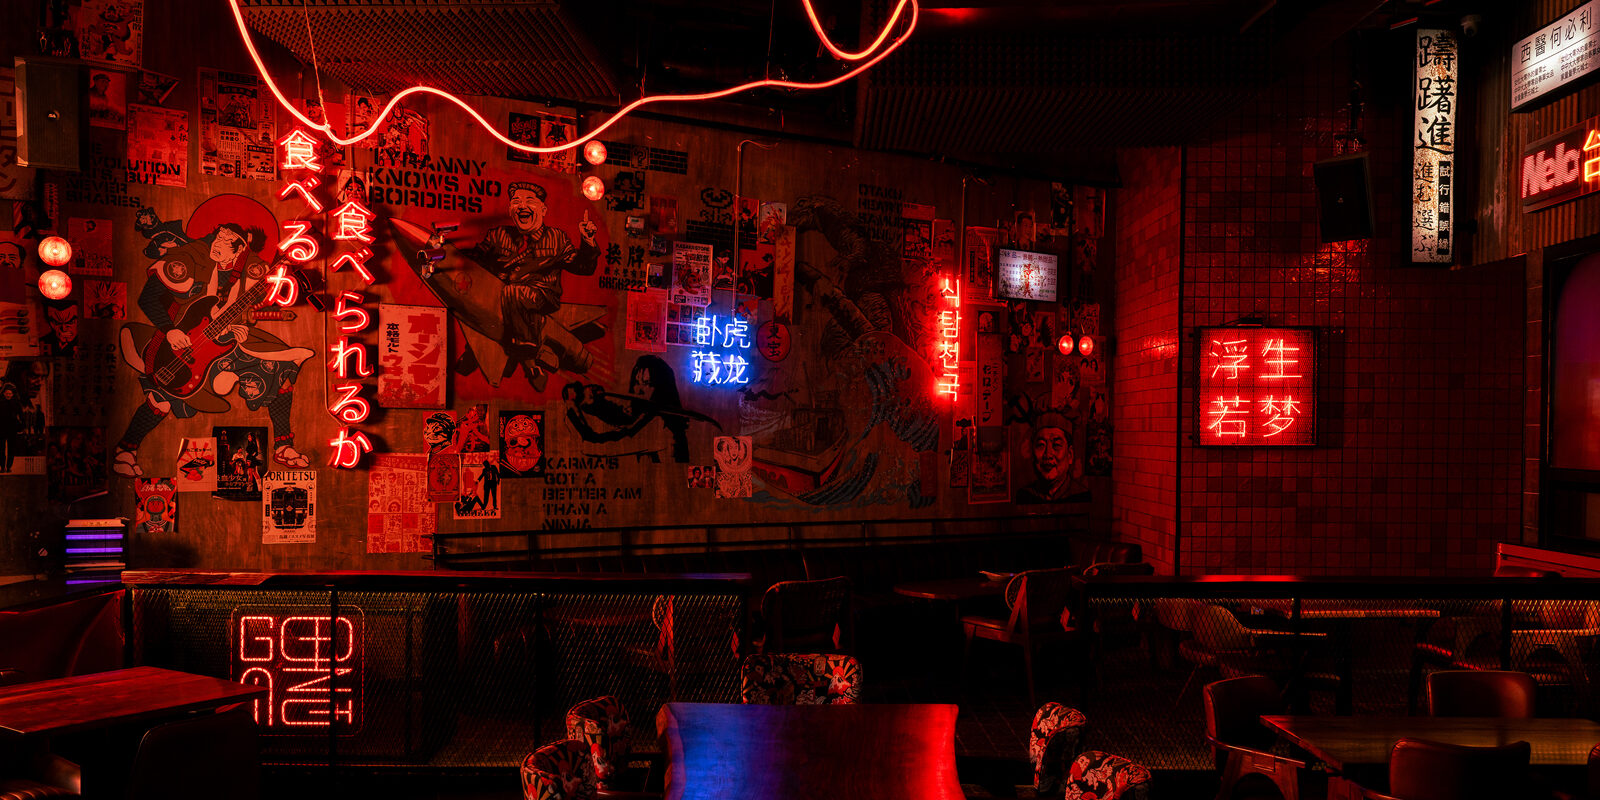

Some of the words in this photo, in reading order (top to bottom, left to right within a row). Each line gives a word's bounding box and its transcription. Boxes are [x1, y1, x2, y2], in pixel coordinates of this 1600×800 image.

[1520, 6, 1592, 64] 西醫何必利
[369, 147, 487, 177] TYRANNY
[66, 176, 128, 194] NEVER
[124, 170, 160, 186] BUT
[369, 166, 460, 193] KNOWS
[468, 179, 502, 197] NO
[858, 183, 903, 200] OTAKU
[369, 185, 482, 213] BORDERS
[858, 199, 903, 215] HEART
[266, 129, 323, 308] 食べるか
[328, 202, 374, 469] 食べられるか
[696, 314, 751, 348] 卧虎
[938, 278, 962, 402] 식탐천국
[1207, 338, 1303, 380] 浮生
[1207, 394, 1302, 438] 若梦
[544, 472, 579, 485] GOT
[585, 473, 596, 485] A
[543, 487, 607, 500] BETTER
[613, 487, 641, 500] AIM
[542, 503, 590, 515] THAN
[597, 503, 607, 515] A
[542, 518, 592, 530] NINJA
